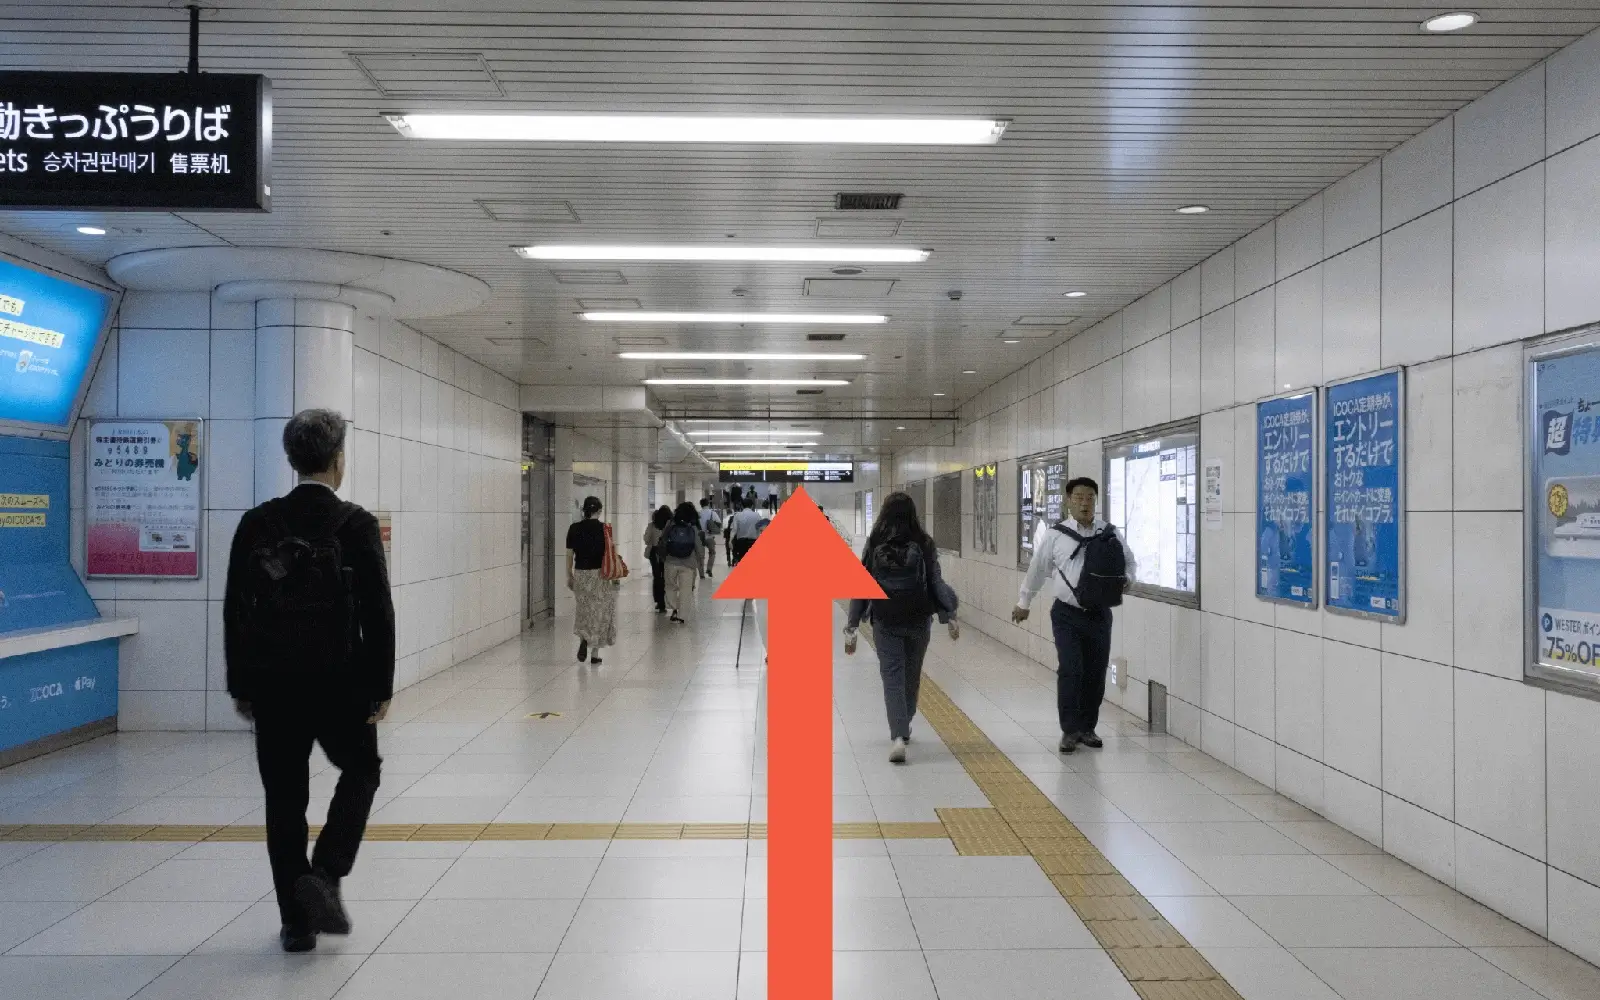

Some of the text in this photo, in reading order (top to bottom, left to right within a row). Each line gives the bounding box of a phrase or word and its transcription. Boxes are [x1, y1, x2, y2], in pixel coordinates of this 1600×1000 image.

[43, 152, 155, 174] 승차권판매기
[170, 152, 231, 174] 售票机
[1264, 427, 1310, 450] エントリー
[1334, 412, 1393, 442] エントリー
[1547, 415, 1568, 449] 超
[94, 458, 165, 468] みどりの券売機
[1264, 450, 1310, 474] するだけで
[1334, 440, 1394, 470] するだけで
[1556, 619, 1580, 633] WESTER
[29, 682, 63, 703] ICOCA
